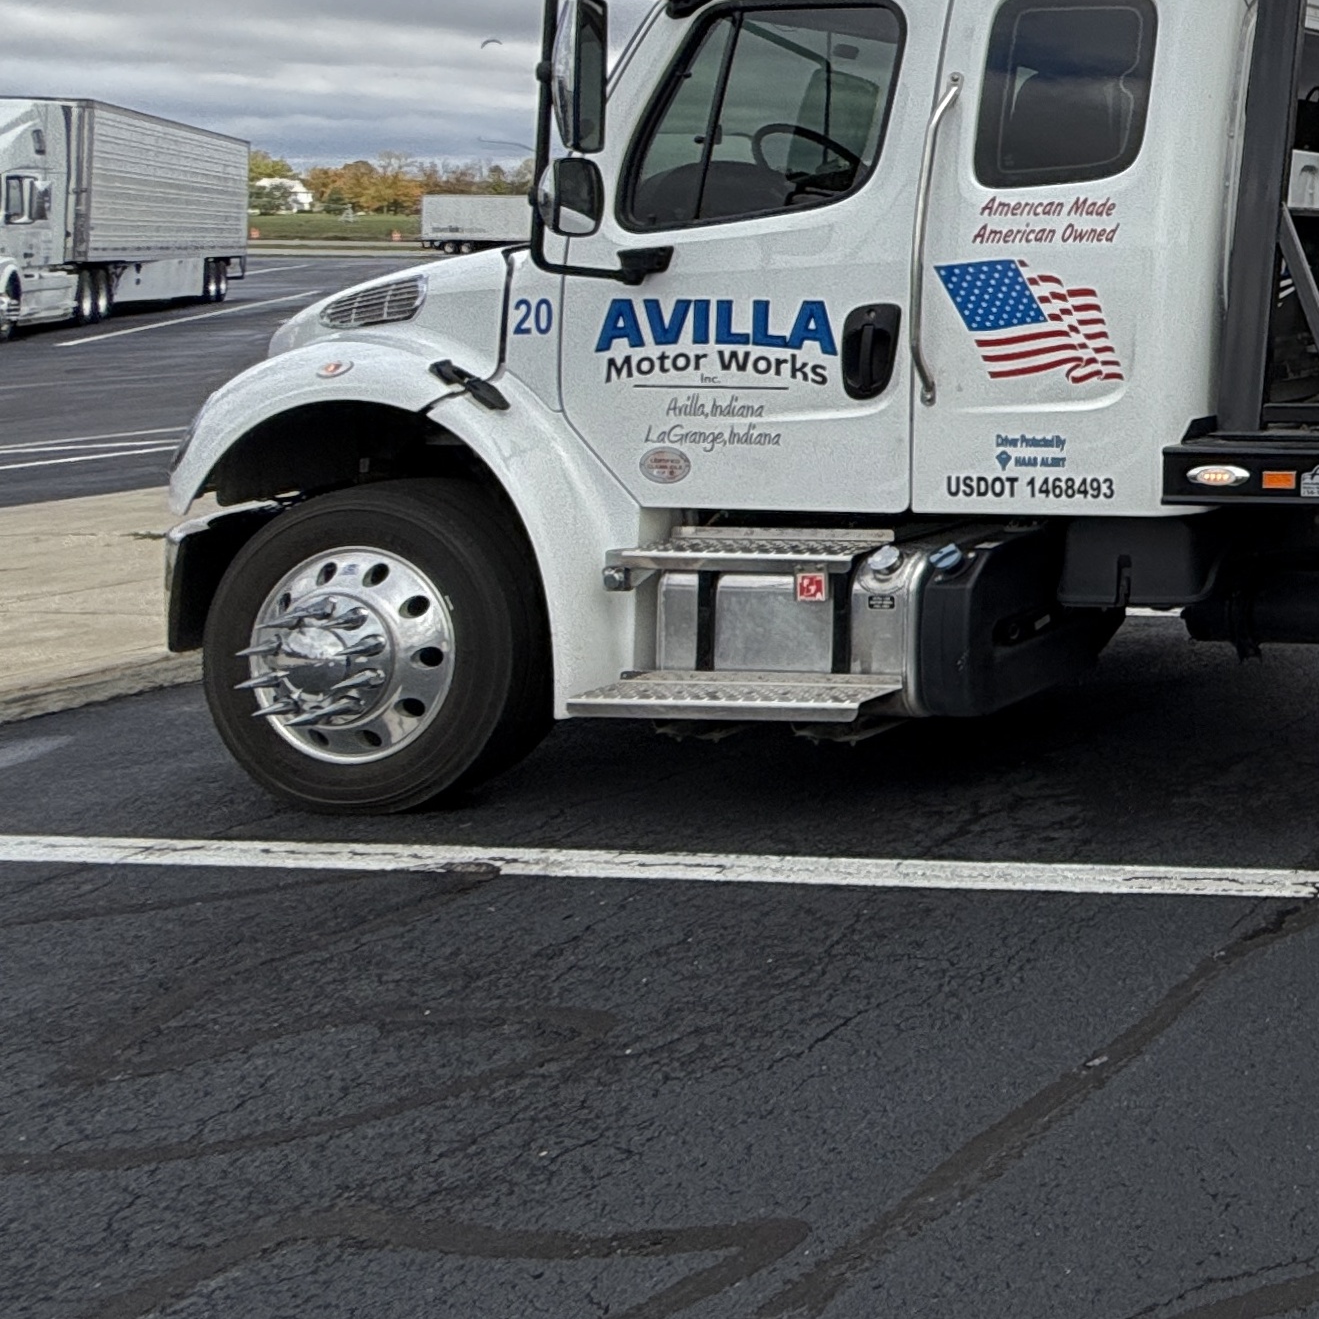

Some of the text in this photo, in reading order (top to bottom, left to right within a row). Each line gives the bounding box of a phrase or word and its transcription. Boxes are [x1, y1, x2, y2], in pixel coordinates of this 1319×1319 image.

[980, 196, 1116, 216] American Made
[972, 223, 1120, 244] American Owned
[513, 298, 553, 335] 20
[594, 298, 838, 356] AVILLA
[605, 350, 828, 385] Motor Works
[700, 372, 720, 384] Inc.
[996, 434, 1019, 448] Driver
[1055, 435, 1066, 452] By
[947, 476, 1115, 499] USDOT 1468493
